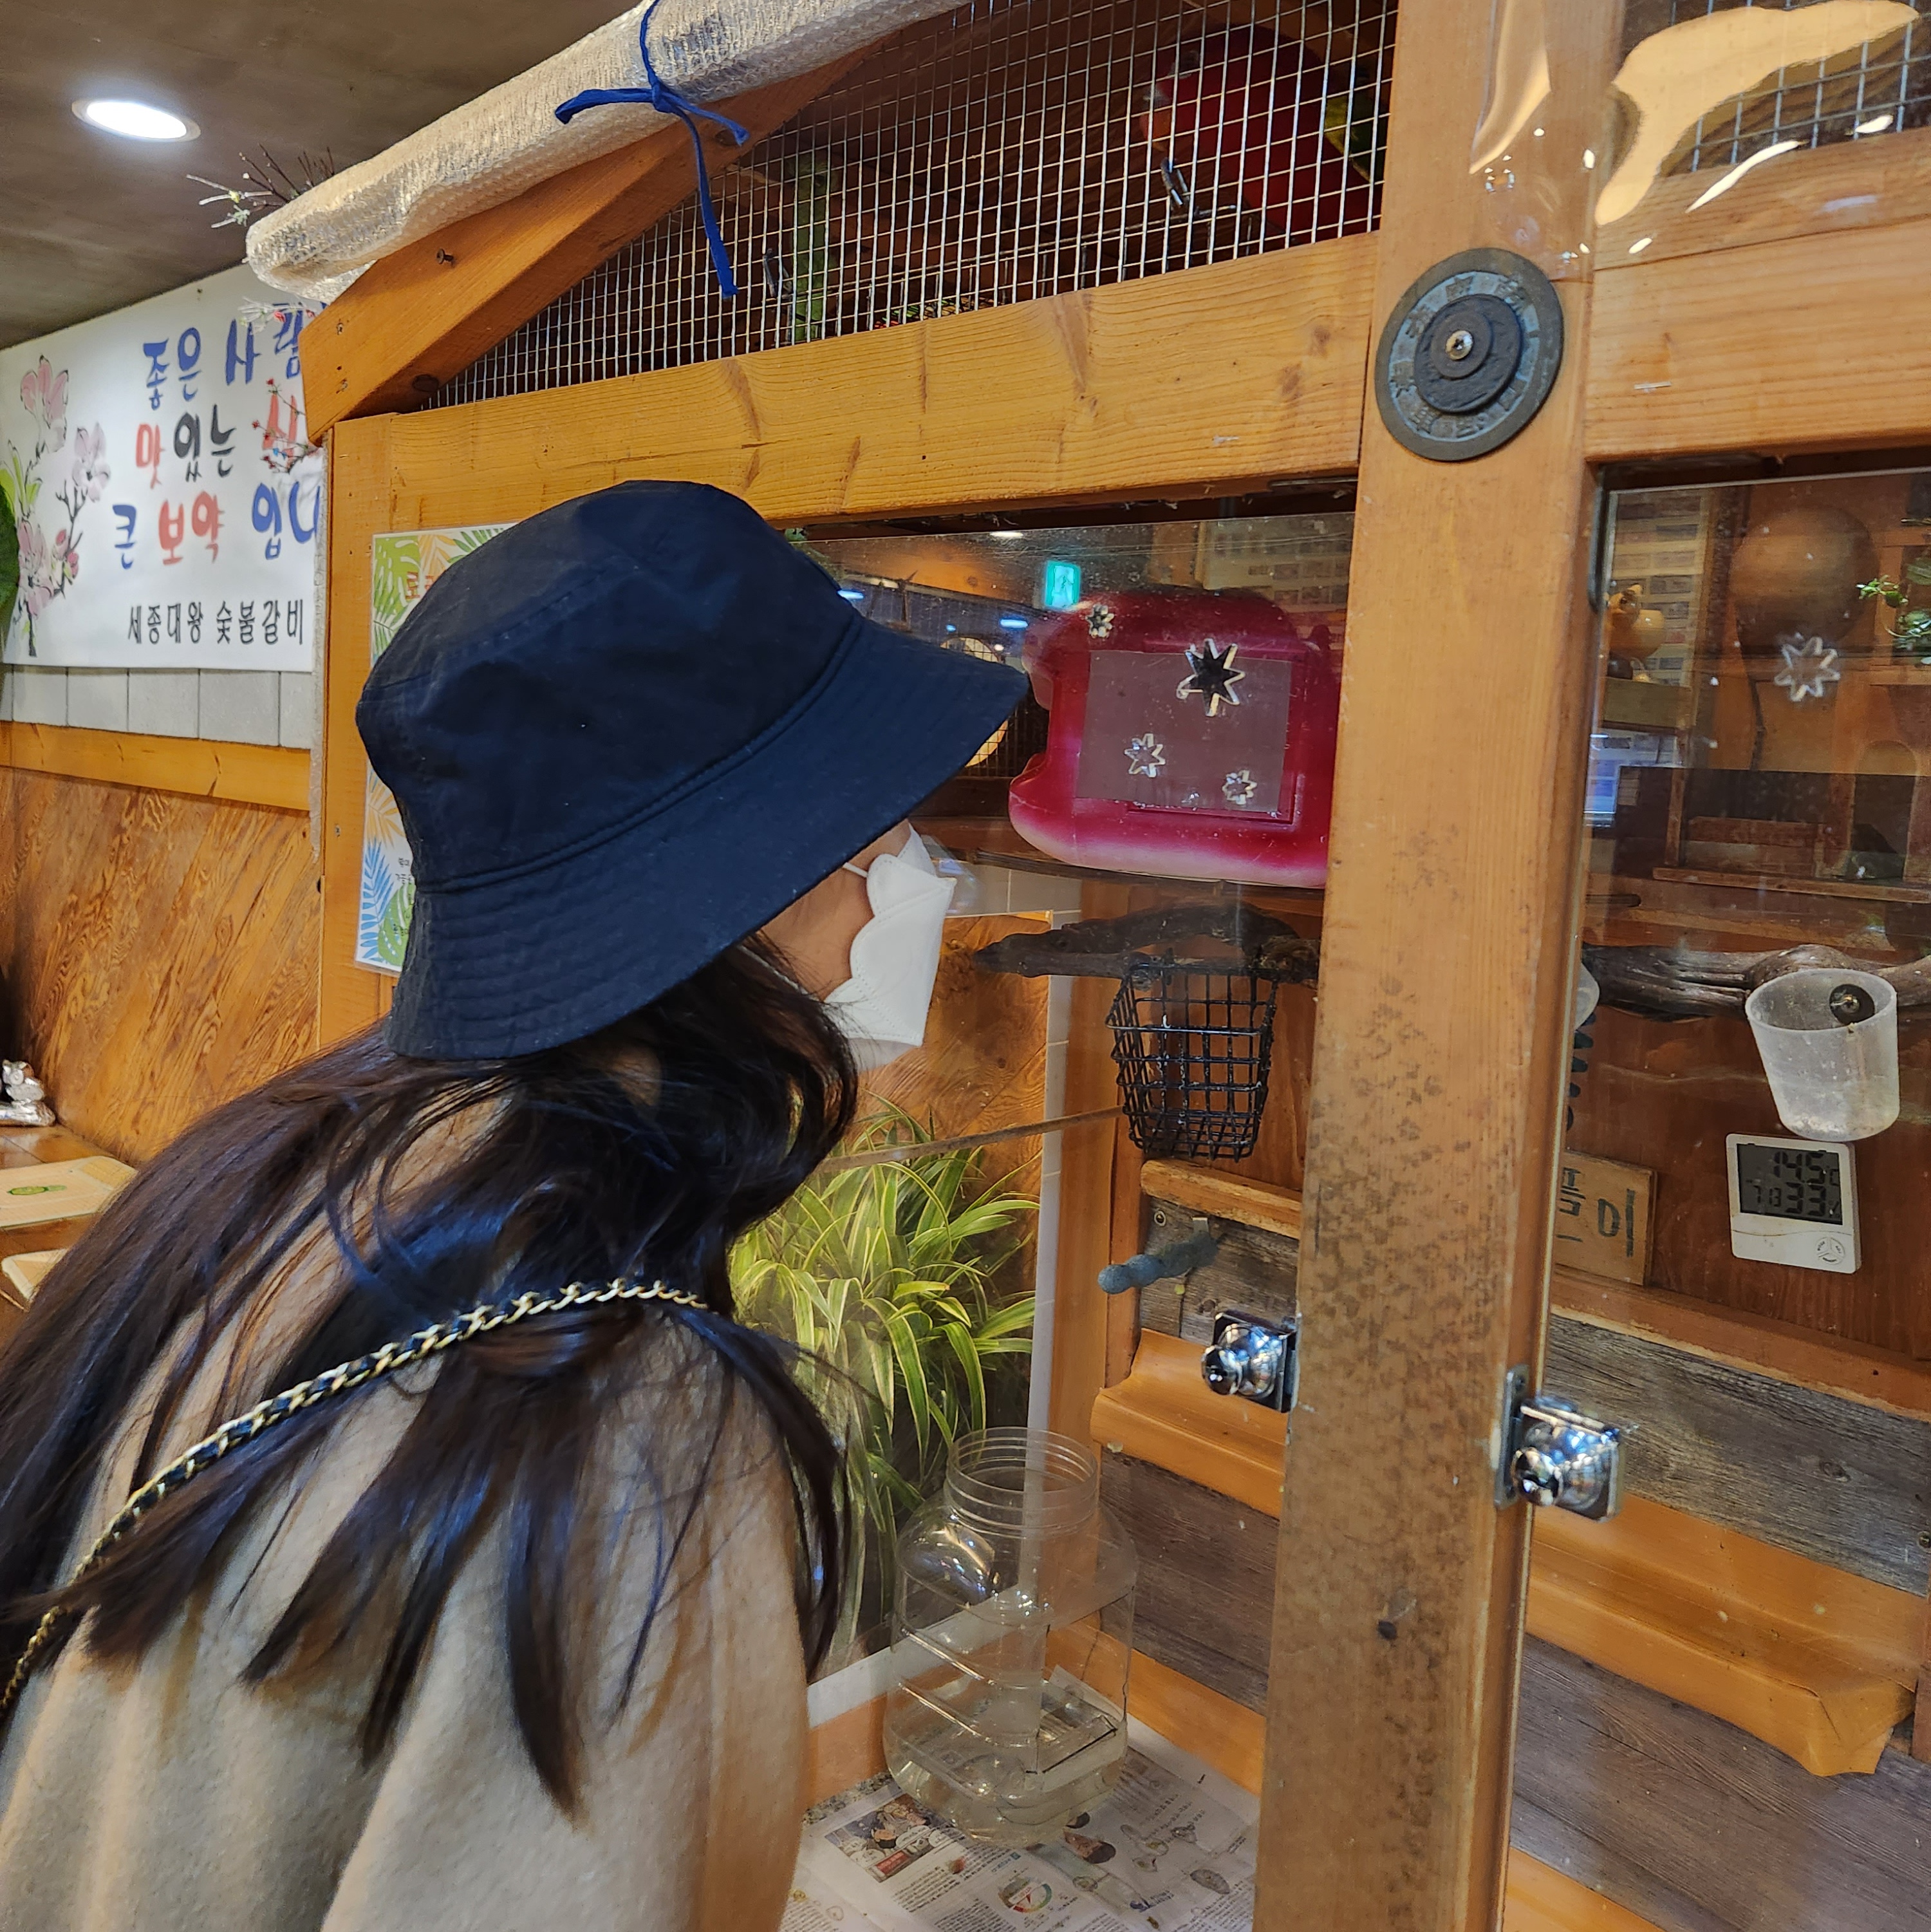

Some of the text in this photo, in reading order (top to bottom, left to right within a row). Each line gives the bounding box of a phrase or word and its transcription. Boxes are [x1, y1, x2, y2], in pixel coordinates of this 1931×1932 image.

[143, 301, 327, 411] 좋은 사람
[135, 403, 236, 490] 맛있는
[112, 481, 321, 570] 큰 보약 입니
[128, 601, 203, 644] 세종대왕
